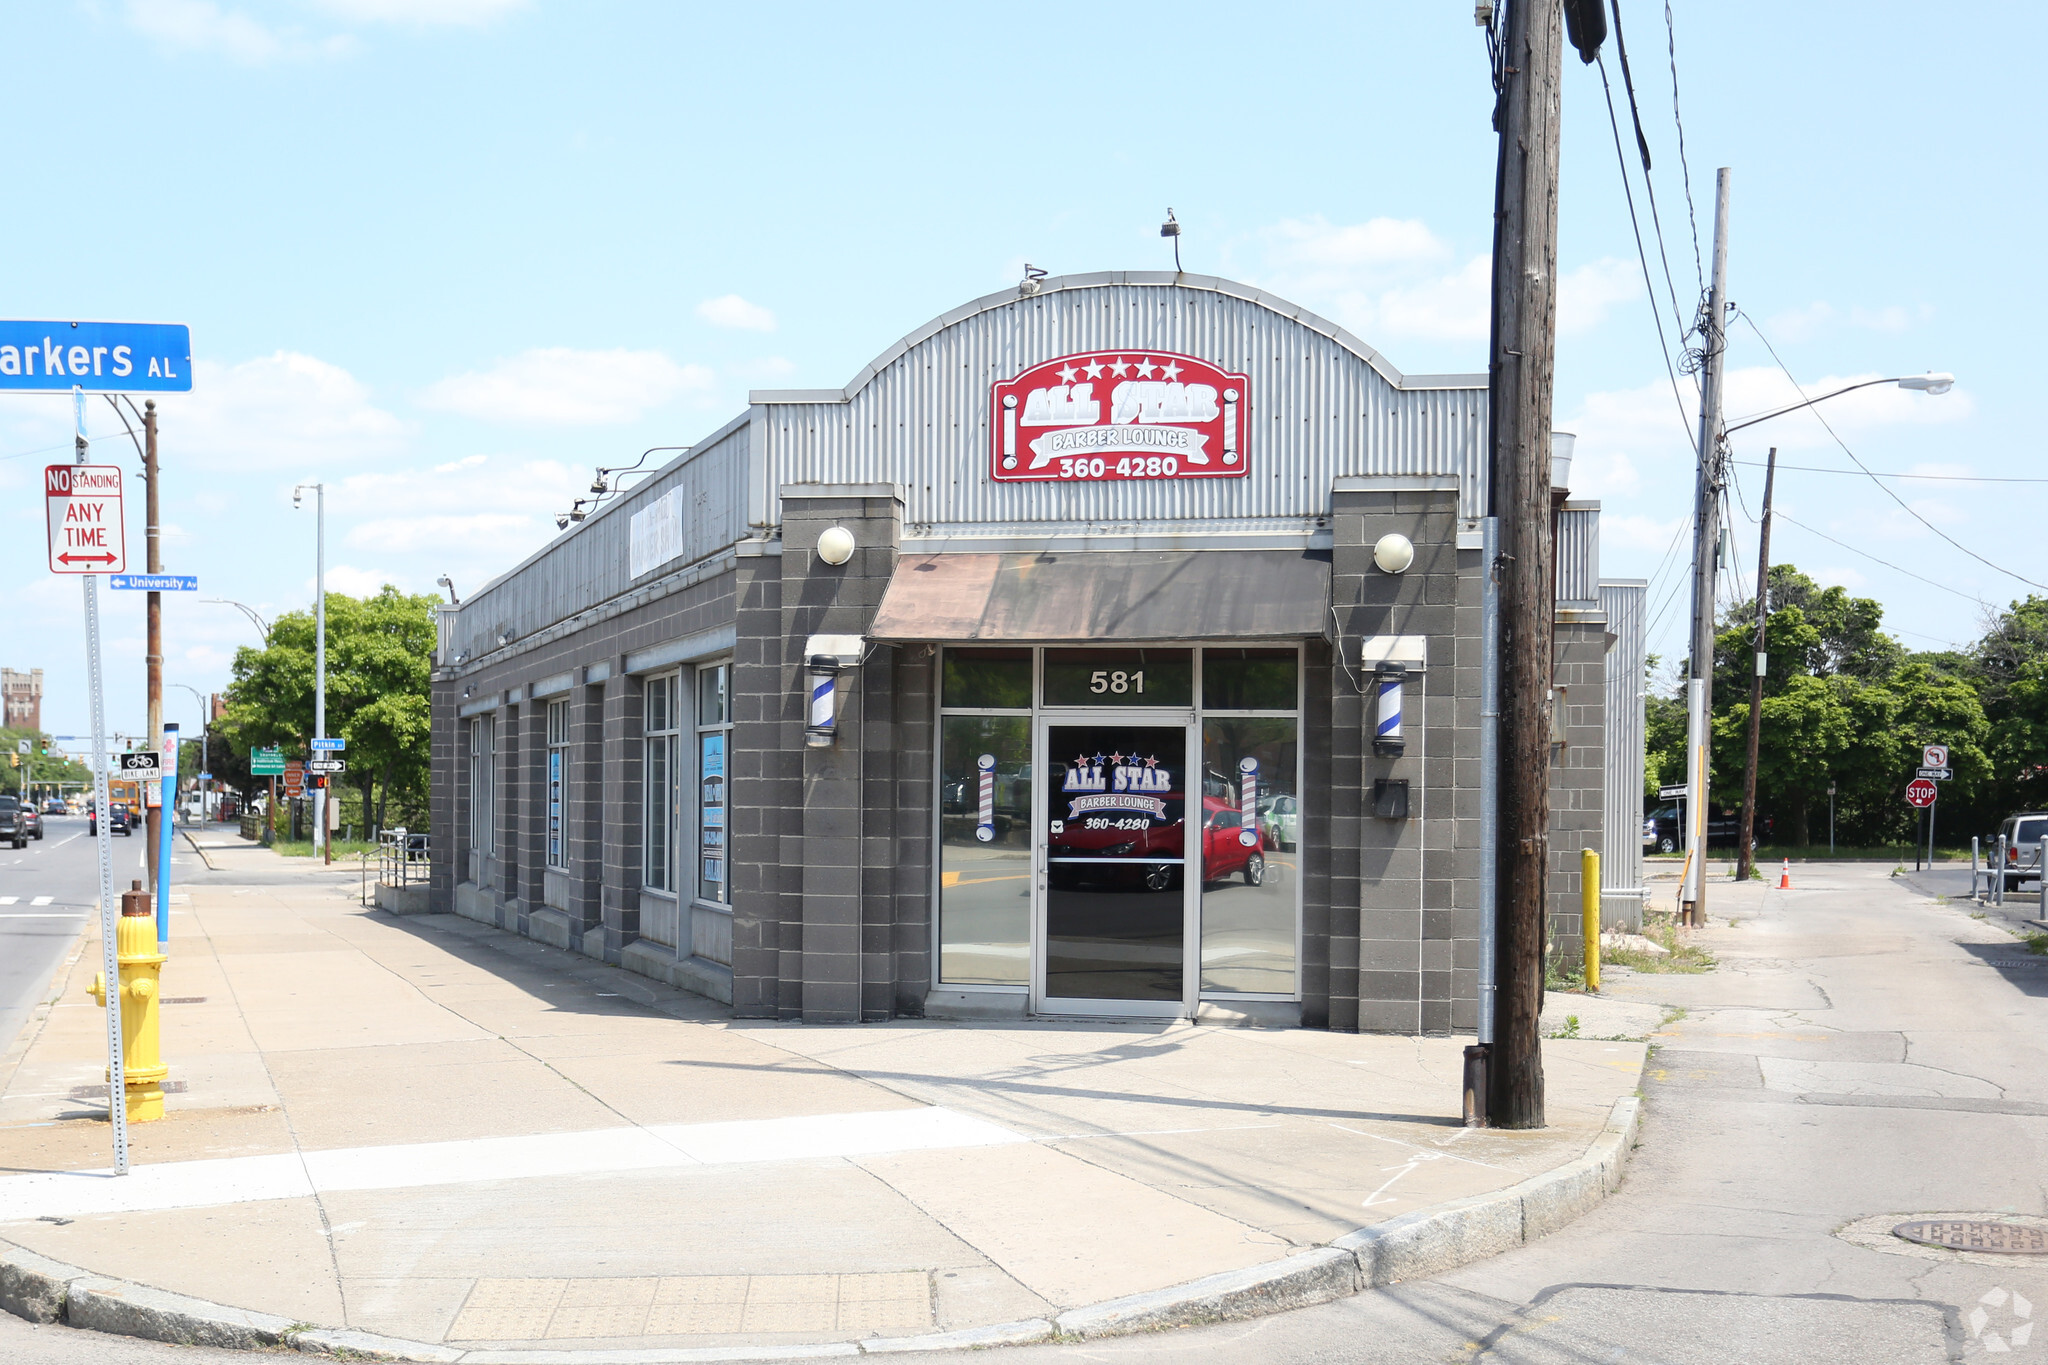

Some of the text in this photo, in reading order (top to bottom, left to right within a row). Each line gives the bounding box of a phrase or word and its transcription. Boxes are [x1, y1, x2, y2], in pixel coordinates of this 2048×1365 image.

[147, 357, 177, 378] AL
[1020, 381, 1220, 426] ALL STAR
[1052, 429, 1188, 450] BARBER LOUNGE
[1059, 456, 1178, 478] 360-4280
[47, 469, 119, 491] NO STANDING
[66, 503, 104, 522] ANY
[64, 528, 107, 547] TIME
[129, 576, 183, 590] University
[1090, 671, 1144, 694] 581
[313, 740, 335, 748] Pitkin
[124, 769, 158, 779] BIKE LANE
[1062, 766, 1171, 793] ALL STAR
[1908, 787, 1935, 798] STOP
[1080, 796, 1155, 810] BARBER LOUNGE
[1084, 817, 1150, 830] 360-4280
